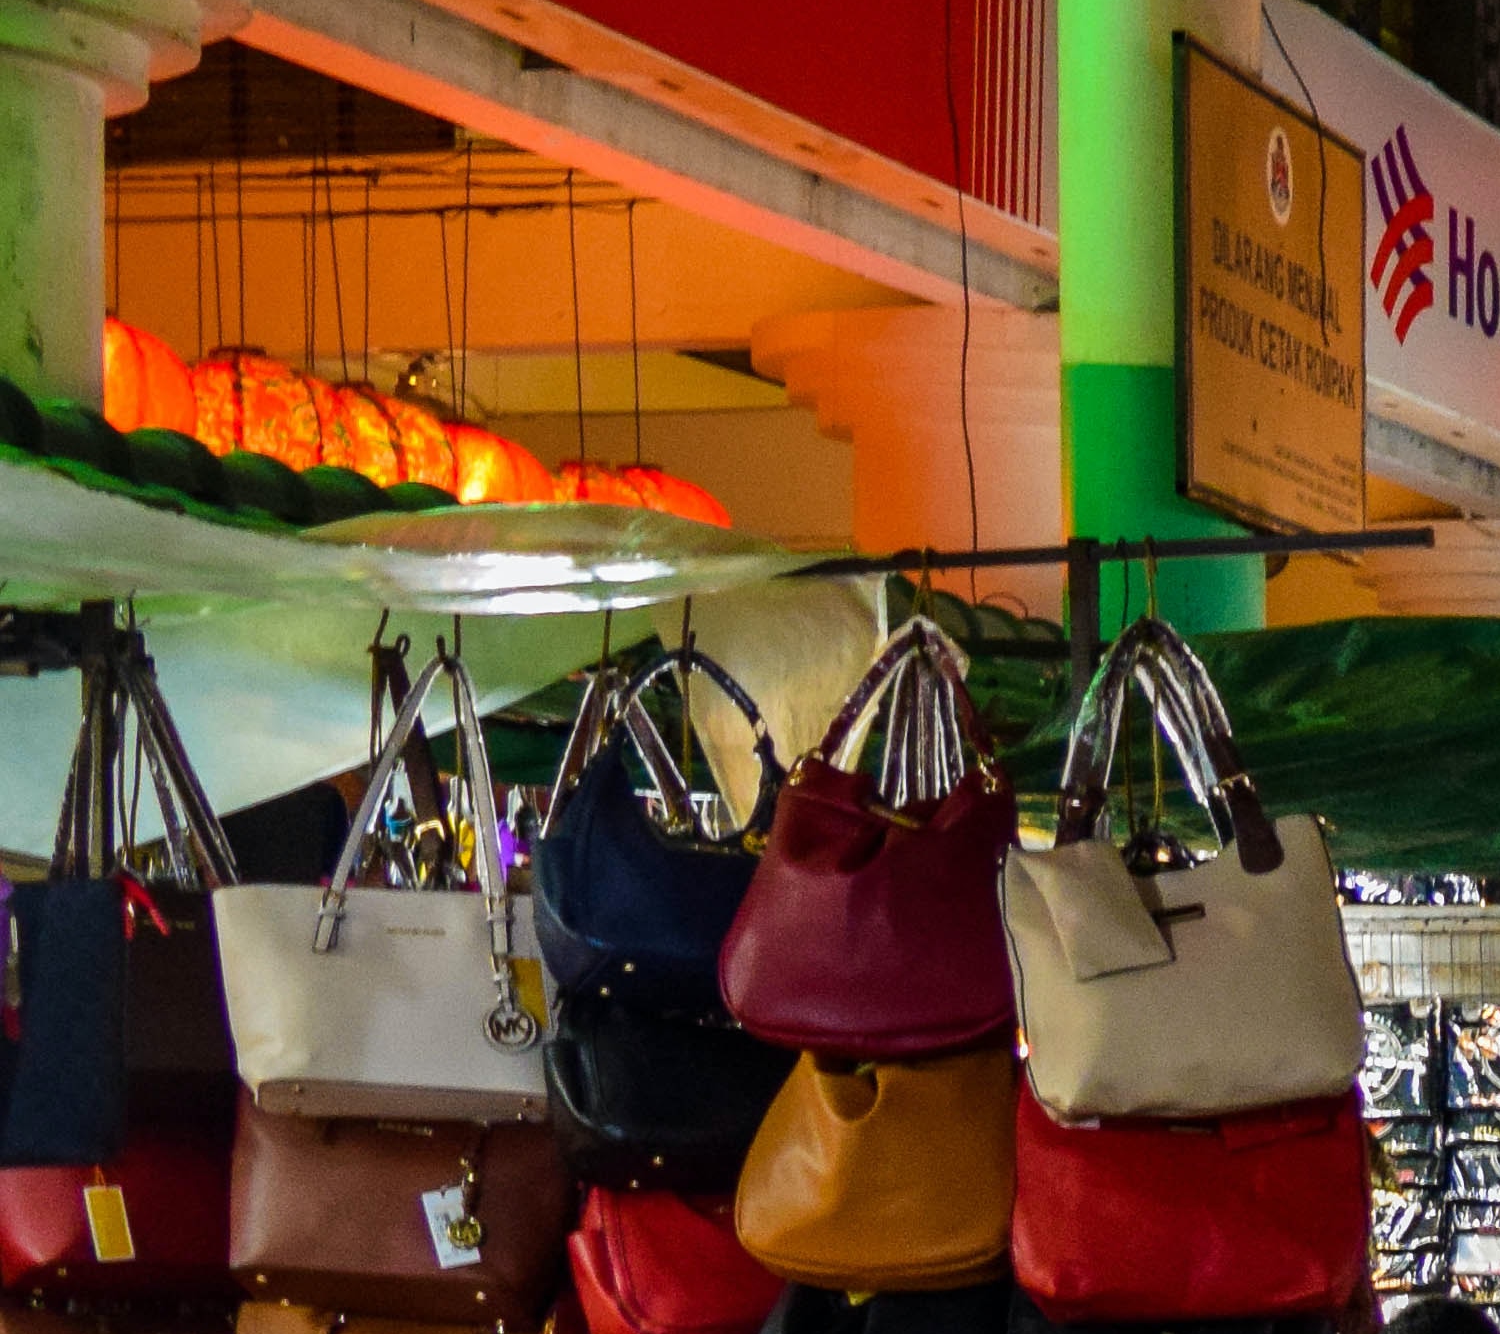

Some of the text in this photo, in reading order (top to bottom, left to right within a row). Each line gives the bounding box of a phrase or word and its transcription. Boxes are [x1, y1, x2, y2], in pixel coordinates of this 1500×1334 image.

[1211, 219, 1342, 334] DILARANG MENJUAL
[1200, 286, 1356, 412] PRODUK CETAK ROMPAK
